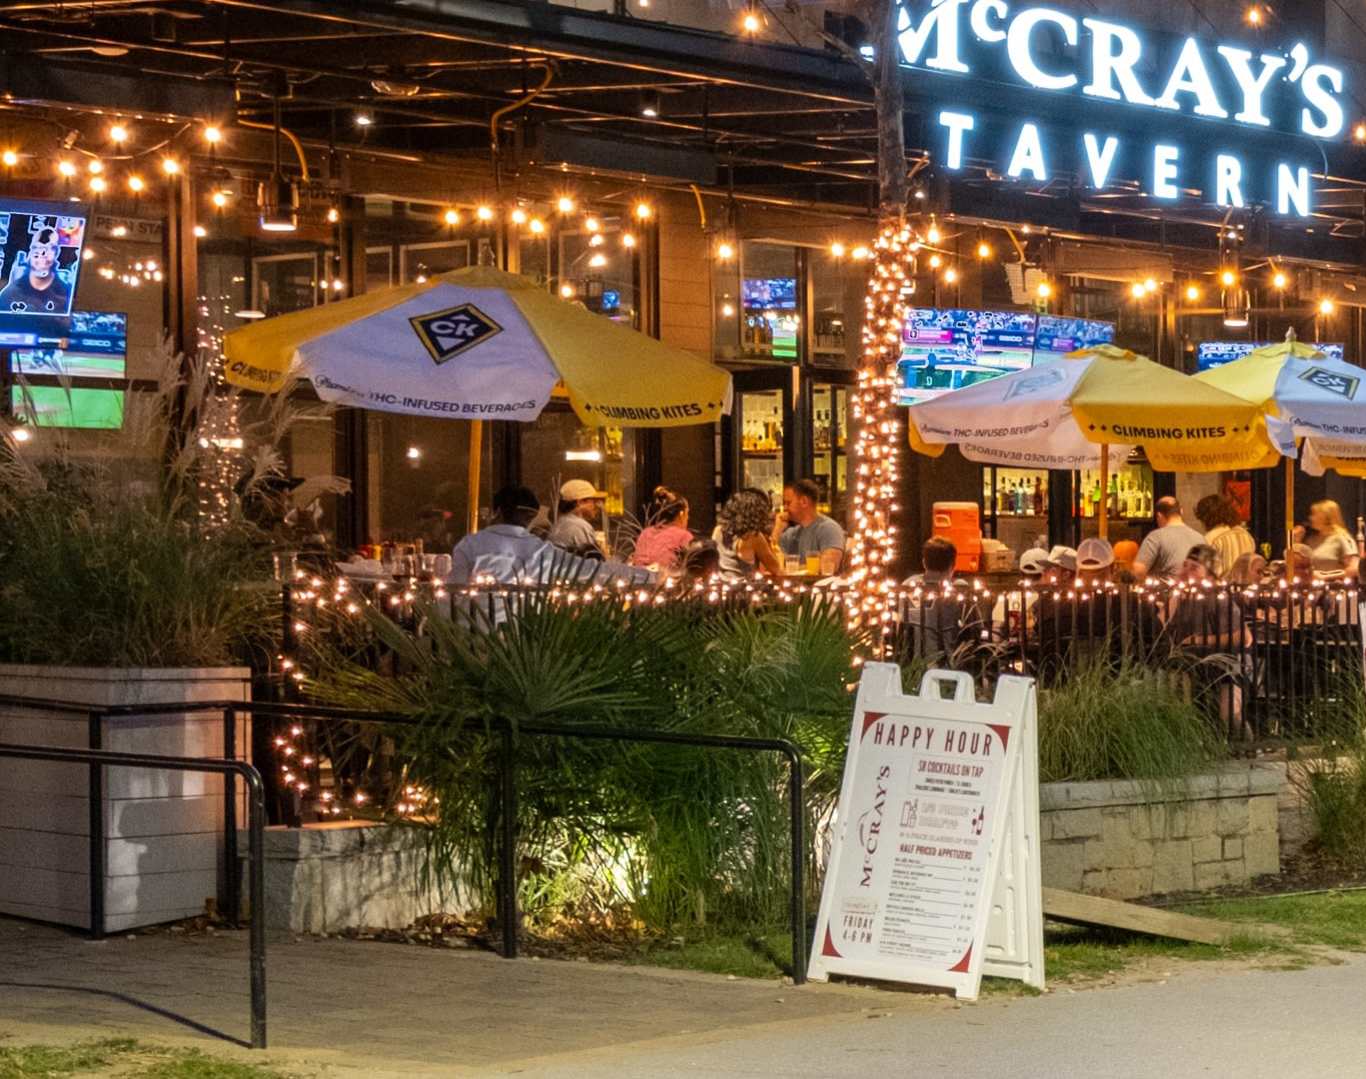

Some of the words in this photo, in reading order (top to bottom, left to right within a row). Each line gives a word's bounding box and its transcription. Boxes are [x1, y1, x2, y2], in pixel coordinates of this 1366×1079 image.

[938, 111, 1310, 217] TAVERN
[430, 319, 478, 338] CK
[600, 404, 661, 421] CLIMBING
[662, 402, 703, 419] KITES
[1112, 423, 1183, 440] CLIMBING
[1186, 426, 1226, 440] KITES
[874, 722, 935, 750] HAPPY
[944, 730, 993, 757] HOUR
[971, 765, 984, 778] TAP
[843, 915, 874, 930] FRIDAY
[843, 930, 857, 942] 4-6
[859, 931, 873, 944] PM
